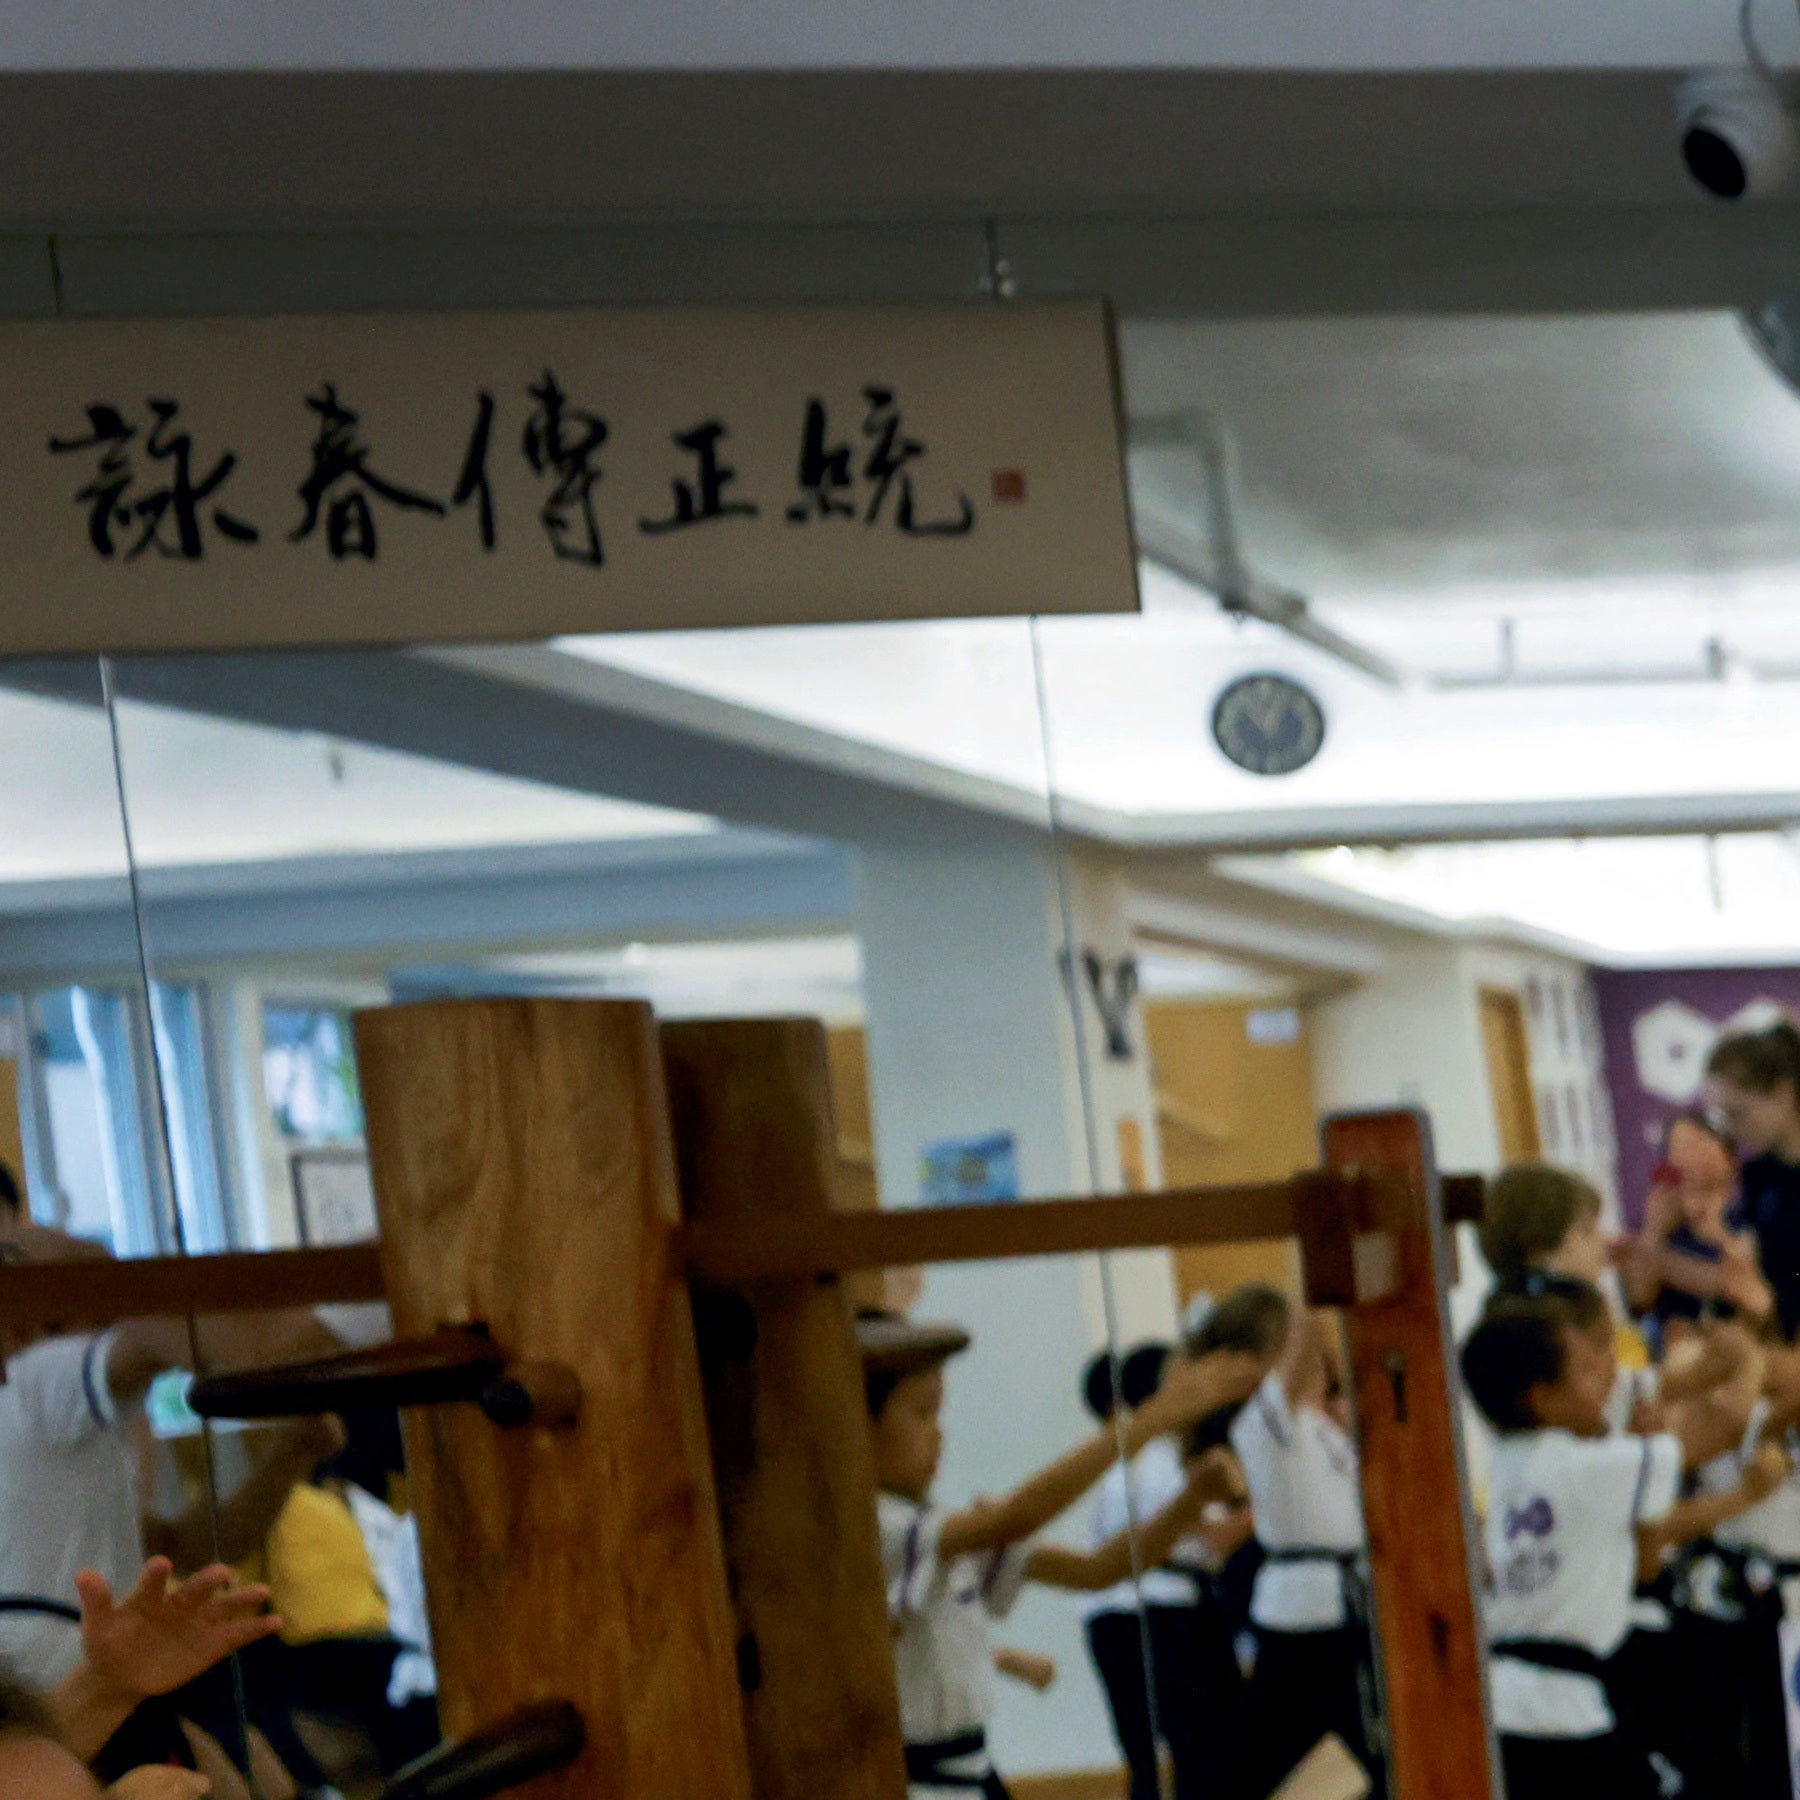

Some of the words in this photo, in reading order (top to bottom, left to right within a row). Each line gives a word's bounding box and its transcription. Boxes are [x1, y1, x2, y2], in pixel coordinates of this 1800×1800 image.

[48, 366, 978, 568] 詠春傳正統
